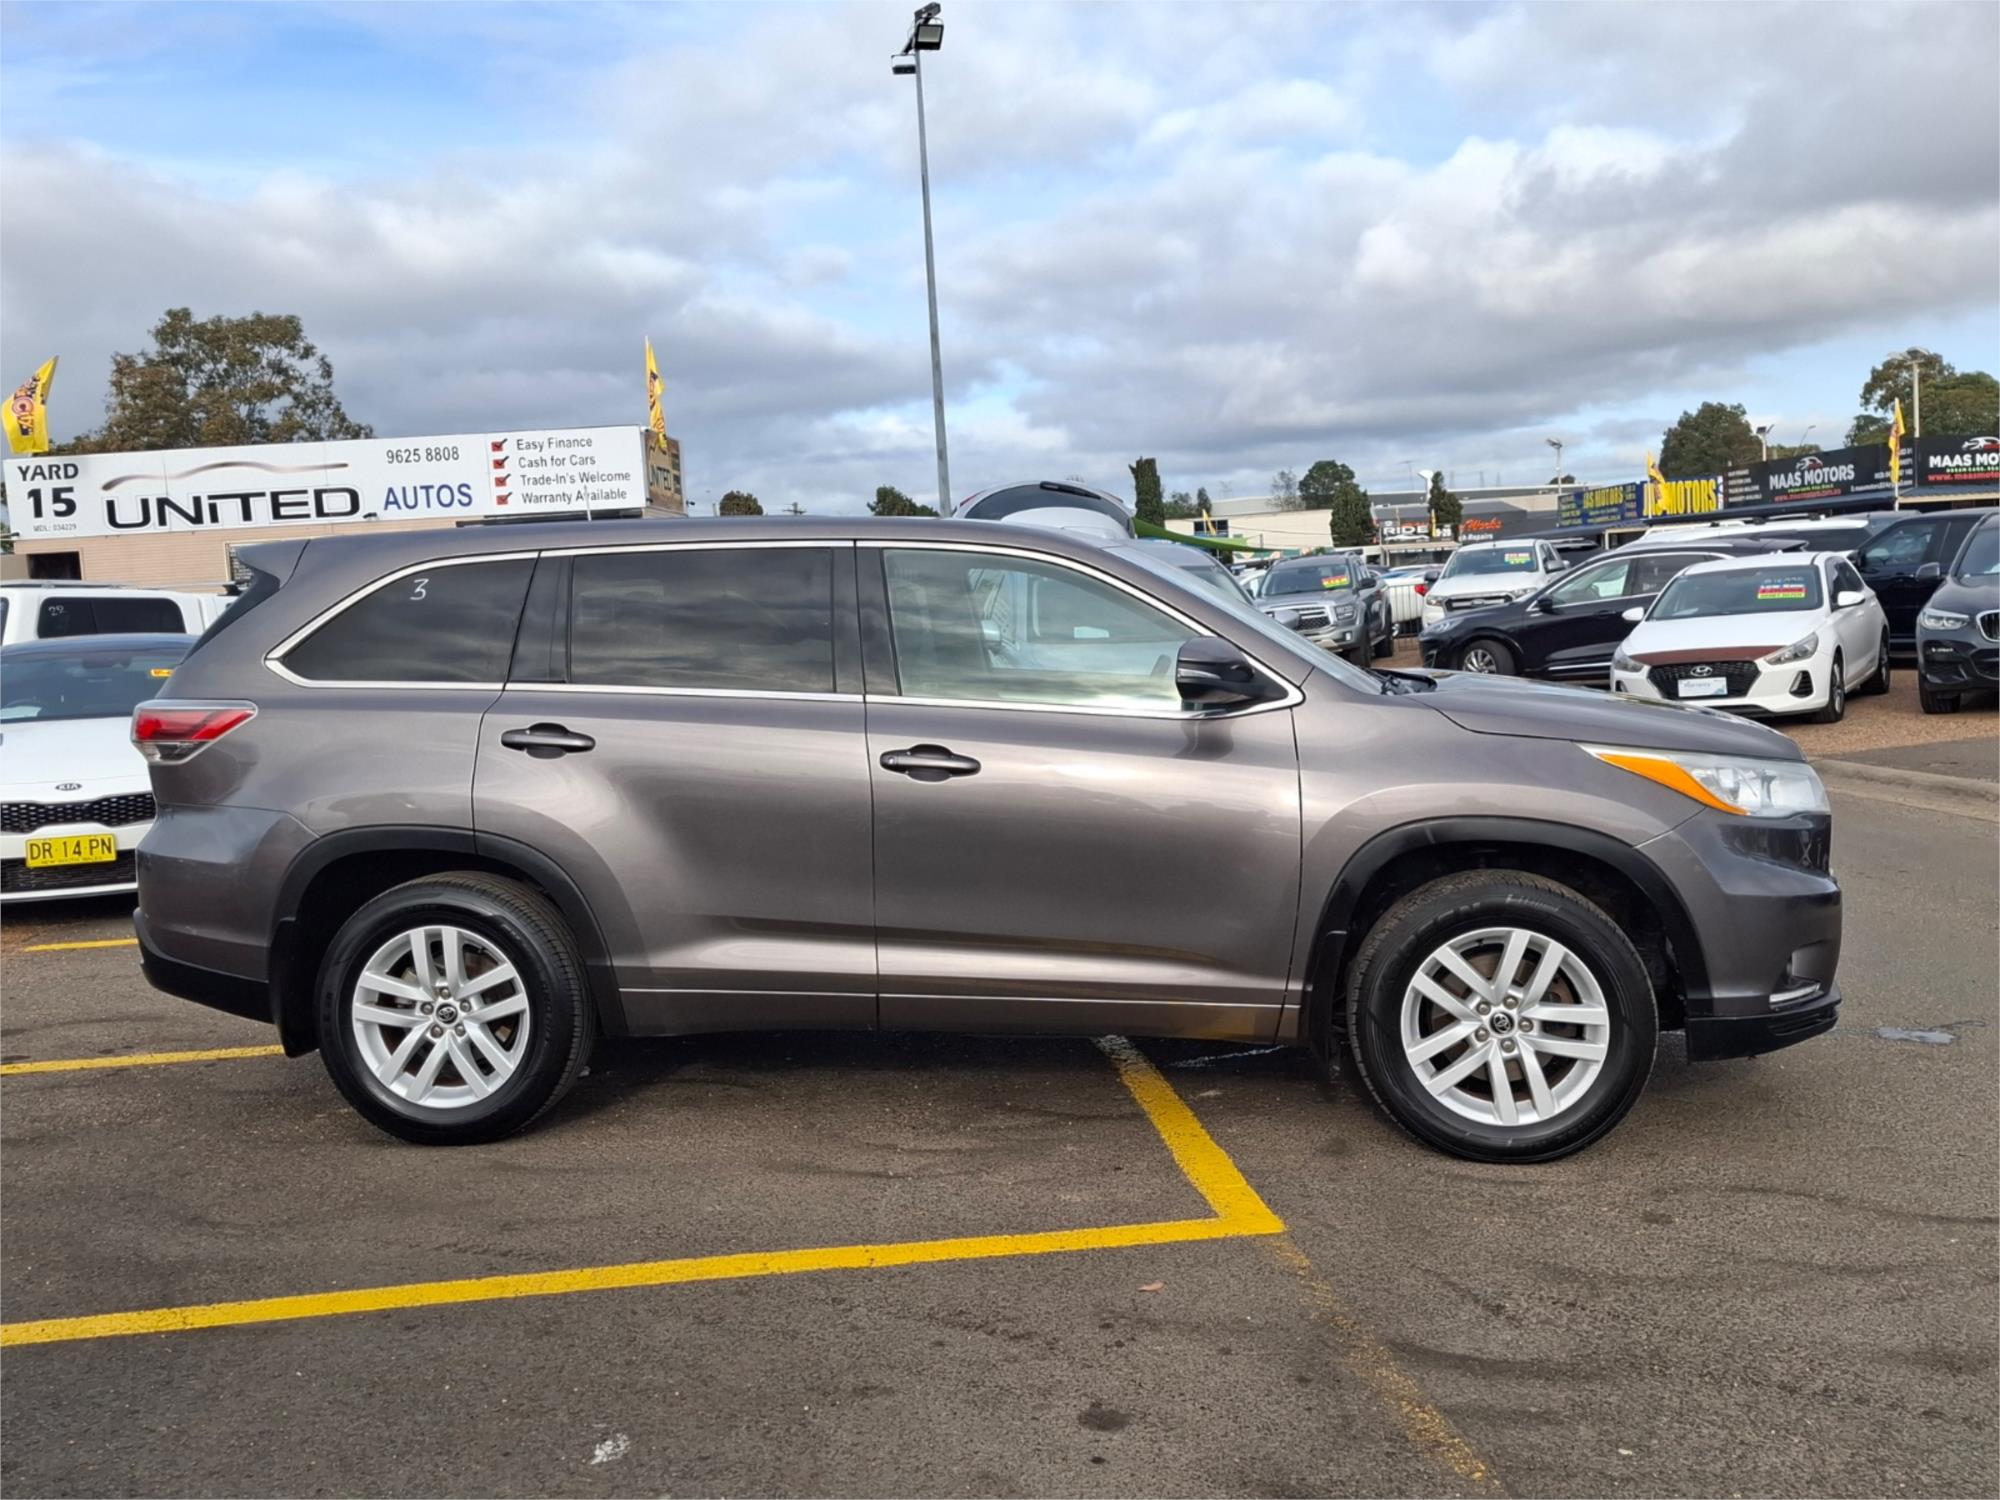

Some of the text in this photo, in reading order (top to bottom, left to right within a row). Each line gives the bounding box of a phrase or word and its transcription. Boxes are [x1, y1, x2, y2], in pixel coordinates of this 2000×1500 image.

[516, 437, 593, 452] Easy Finance
[386, 446, 460, 464] 9625 8808
[518, 454, 596, 469] Cash for Cars
[1929, 454, 1973, 468] MAAS
[1975, 452, 2000, 466] MO
[17, 463, 79, 481] YARD
[520, 471, 631, 486] Trade-In's Welcome
[1769, 471, 1802, 490] MAAS
[1804, 464, 1855, 486] MOTORS
[27, 486, 77, 518] 15
[384, 483, 473, 510] AUTOS
[521, 491, 572, 505] Warranty
[106, 487, 361, 529] UNITED
[1383, 525, 1429, 535] RIDE
[410, 578, 429, 600] 3
[29, 838, 112, 860] DR 14 PN
